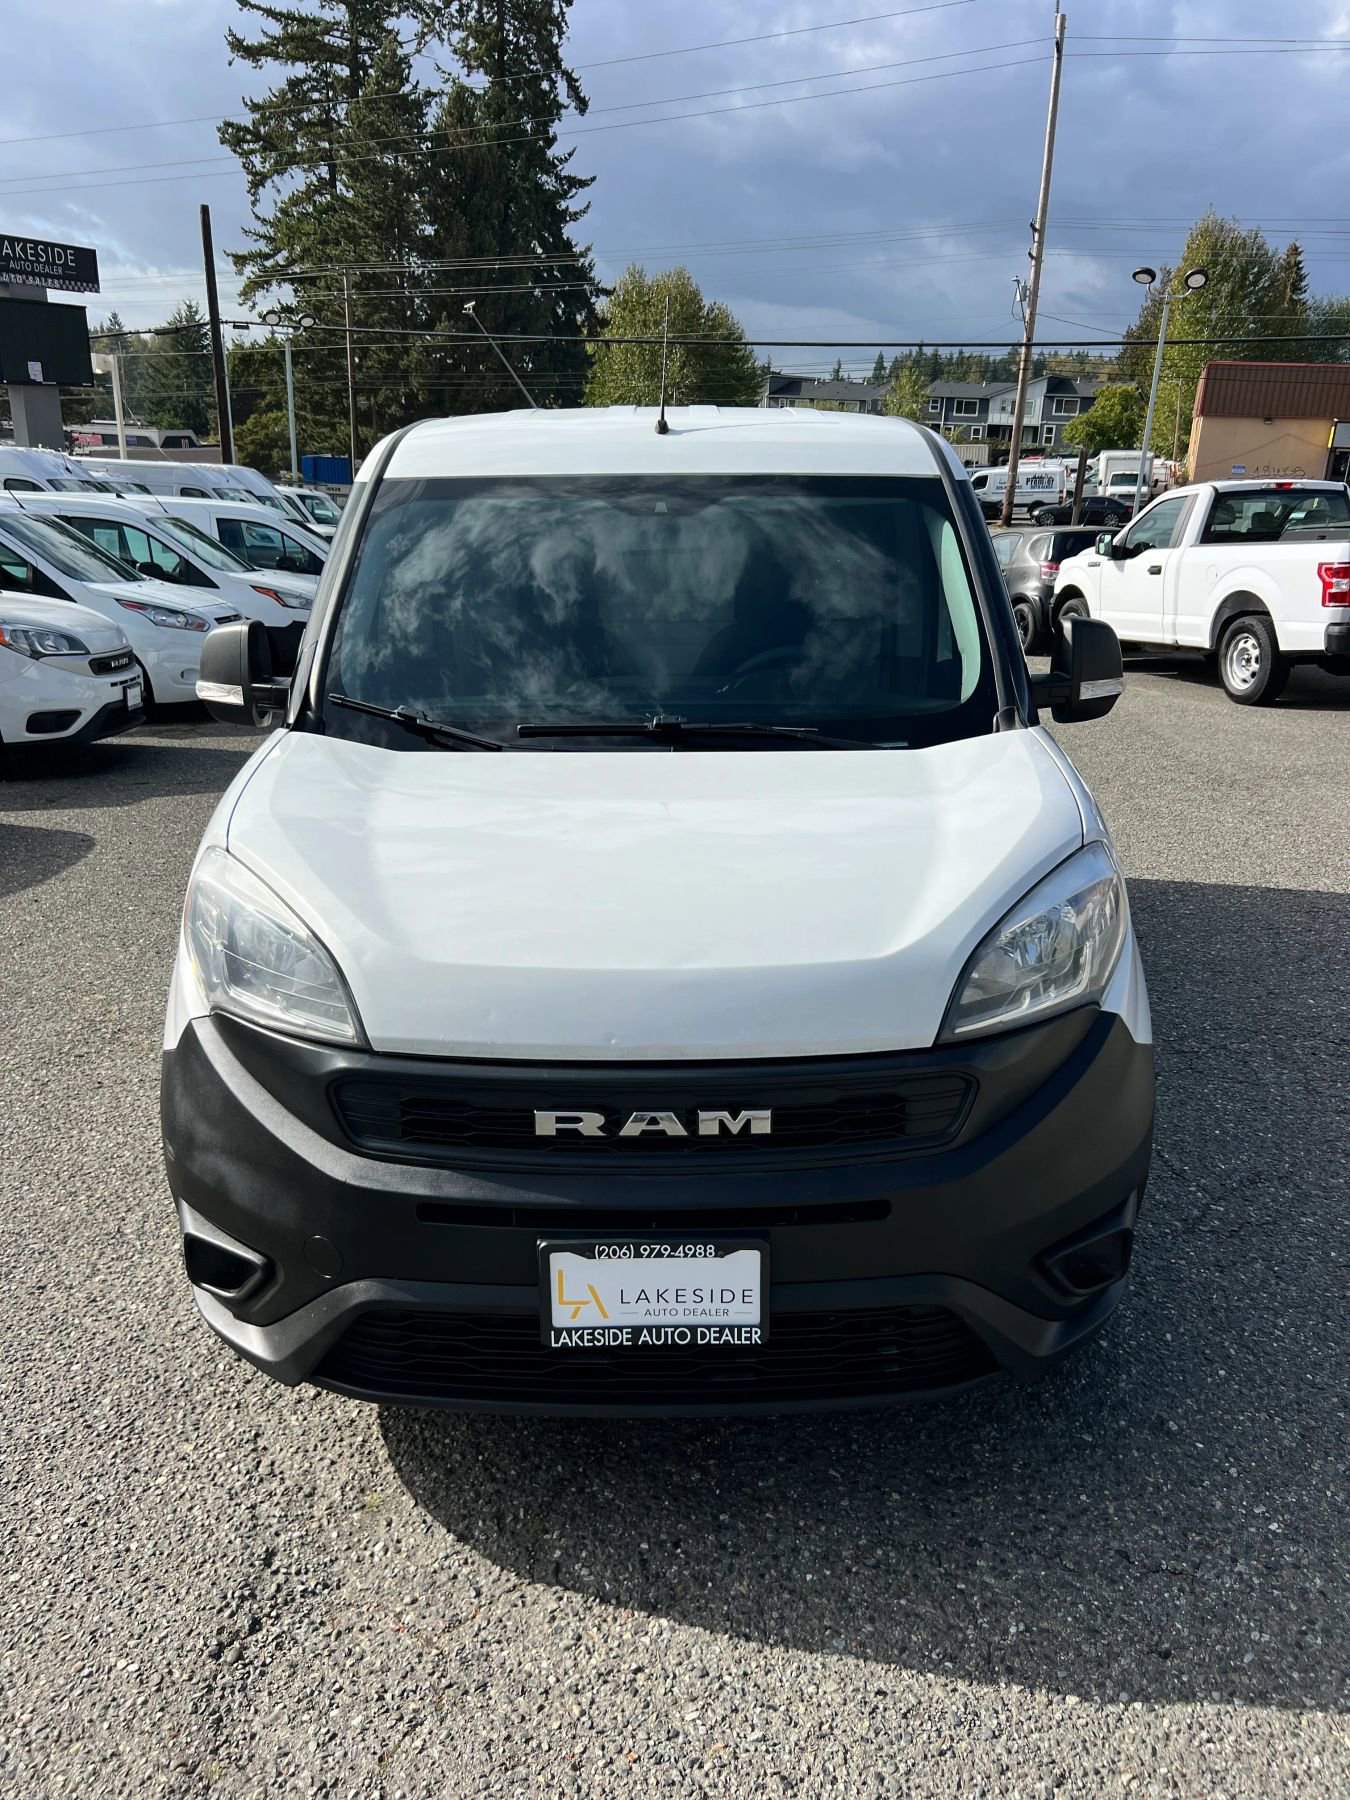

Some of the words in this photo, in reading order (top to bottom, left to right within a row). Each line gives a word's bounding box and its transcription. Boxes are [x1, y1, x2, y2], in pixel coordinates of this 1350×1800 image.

[2, 239, 76, 266] AKESIDE
[9, 259, 32, 272] AUTO
[33, 262, 63, 276] DEALER
[0, 272, 22, 284] UTO
[28, 275, 61, 288] SALES
[534, 1109, 772, 1136] RAM
[594, 1244, 634, 1260] (206)
[640, 1244, 716, 1259] 979-4988
[620, 1288, 754, 1305] LAKESIDE
[644, 1308, 679, 1318] AUTO
[683, 1307, 730, 1317] DEALER
[551, 1328, 632, 1348] LAKESIDE
[638, 1327, 691, 1346] AUTO
[697, 1327, 762, 1345] DEALER
